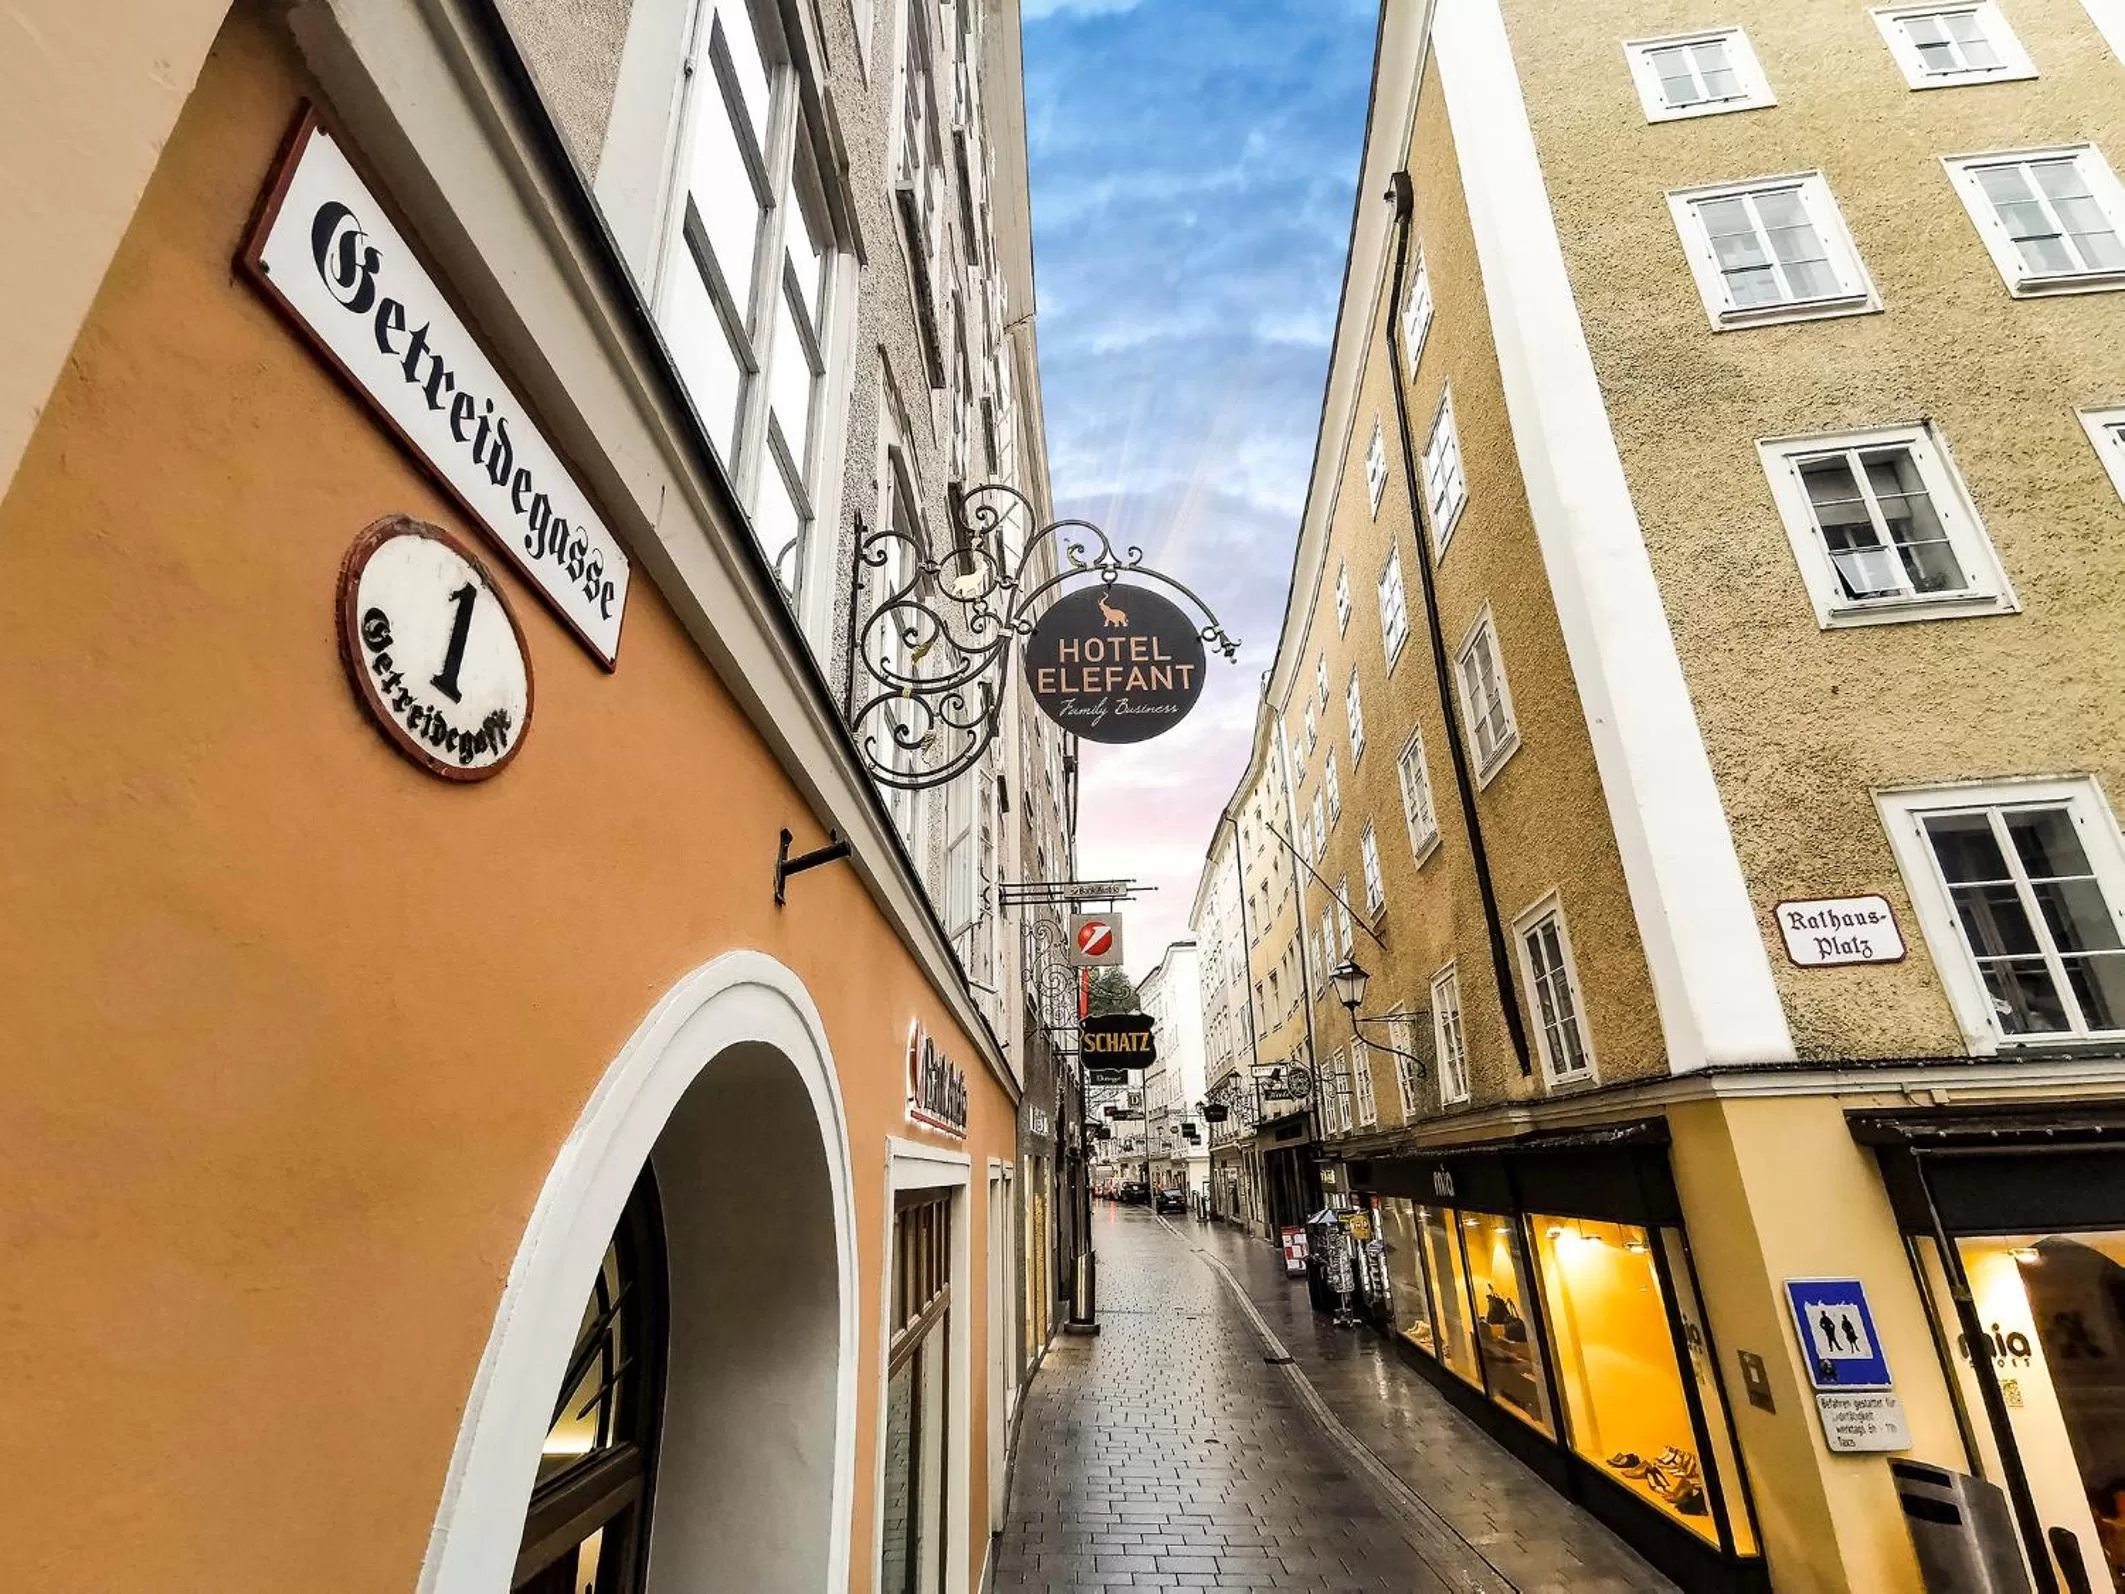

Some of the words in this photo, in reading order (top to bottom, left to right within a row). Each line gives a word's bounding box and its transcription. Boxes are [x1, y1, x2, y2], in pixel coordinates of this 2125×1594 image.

[311, 201, 615, 620] Getreidegasse
[430, 582, 477, 704] 1
[1058, 636, 1172, 663] HOTEL
[1037, 664, 1195, 694] ELEFANT
[1058, 697, 1109, 727] Family
[1114, 697, 1179, 715] Business
[1787, 908, 1887, 932] Rathaus-
[1813, 936, 1874, 960] Platz
[1081, 1031, 1150, 1053] SCHATZ
